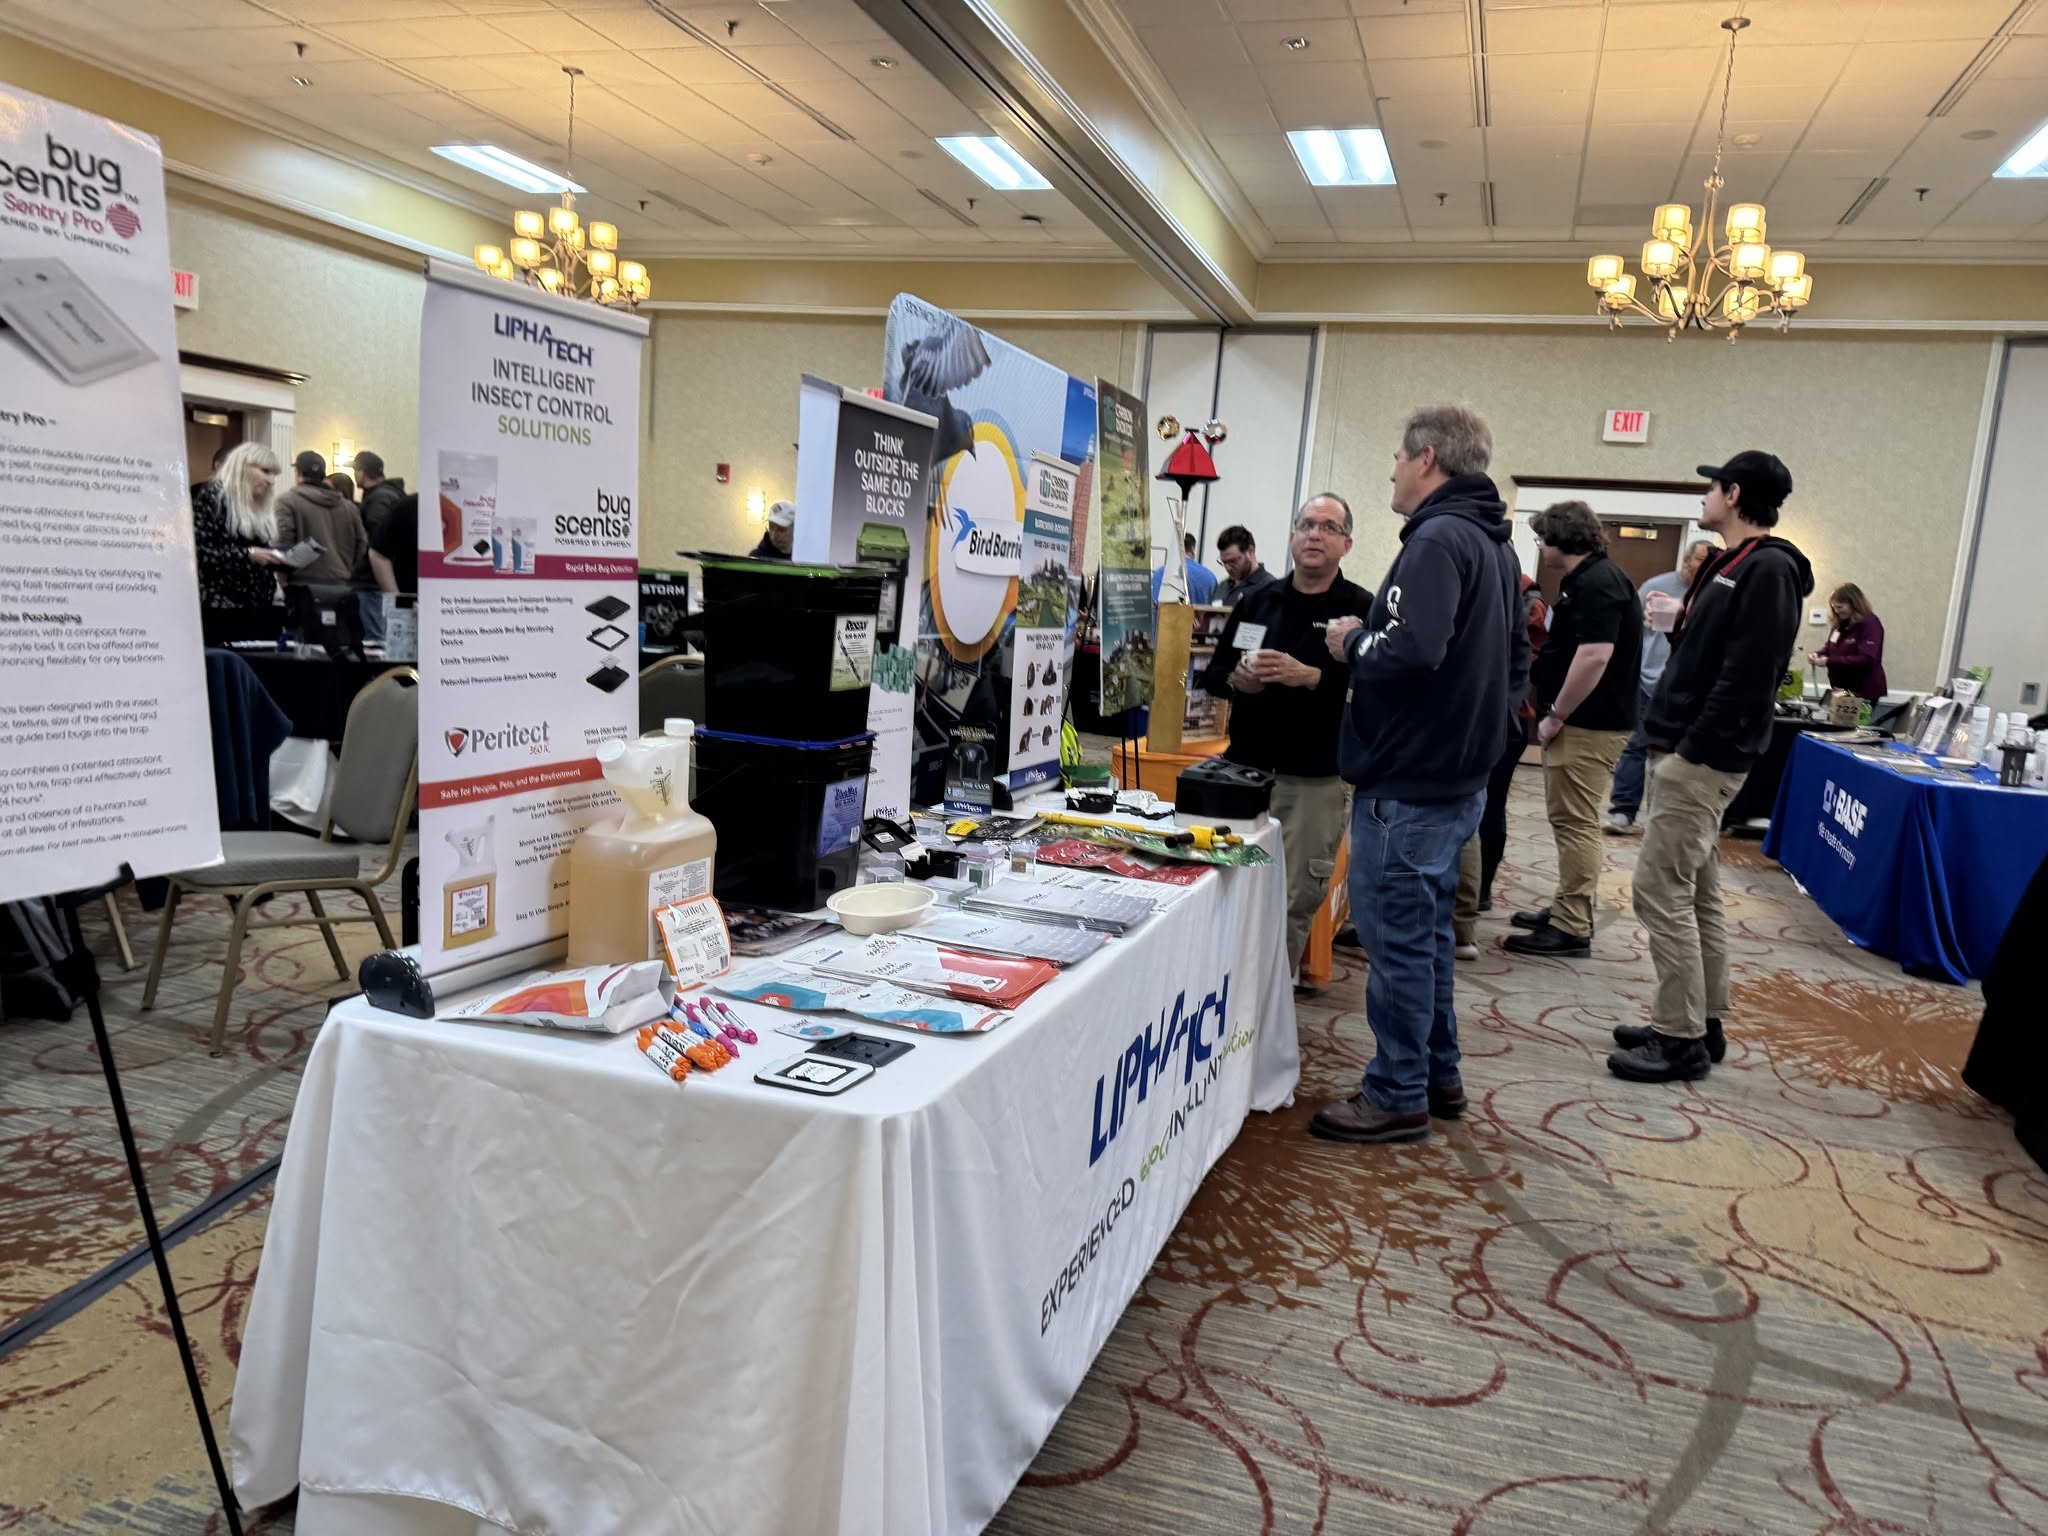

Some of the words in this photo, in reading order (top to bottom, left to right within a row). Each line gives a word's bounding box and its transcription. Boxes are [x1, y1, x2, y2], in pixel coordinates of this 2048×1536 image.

[46, 131, 122, 195] bug
[0, 158, 102, 212] cents
[3, 191, 67, 228] Sentry
[72, 208, 104, 234] Pro
[172, 270, 194, 297] XIT
[494, 311, 593, 368] LIPHATECH
[493, 357, 595, 396] INTELLIGENT
[0, 410, 19, 426] try
[471, 381, 533, 411] INSECT
[537, 394, 613, 425] CONTROL
[498, 414, 592, 446] SOLUTIONS
[1612, 411, 1644, 433] EXIT
[873, 431, 904, 457] THINK
[854, 449, 899, 476] OUTSIDE
[900, 460, 919, 481] THE
[861, 472, 889, 496] SAME
[892, 477, 911, 499] OLD
[598, 487, 631, 522] bug
[866, 495, 905, 518] BLOCKS
[555, 514, 622, 538] scents
[969, 529, 1022, 560] BirdBarrie
[0, 565, 50, 576] reatment
[44, 580, 93, 591] treatment
[641, 583, 685, 596] STORM
[22, 612, 82, 625] Packaging
[0, 654, 44, 667] nhancing
[472, 720, 550, 753] Peritect
[440, 789, 460, 800] Safe
[460, 786, 471, 795] for
[515, 778, 528, 786] and
[529, 775, 539, 784] the
[540, 768, 581, 781] Environment
[1834, 788, 1868, 839] BASF
[680, 902, 708, 919] eritect
[1089, 971, 1231, 1168] LIPHATCH
